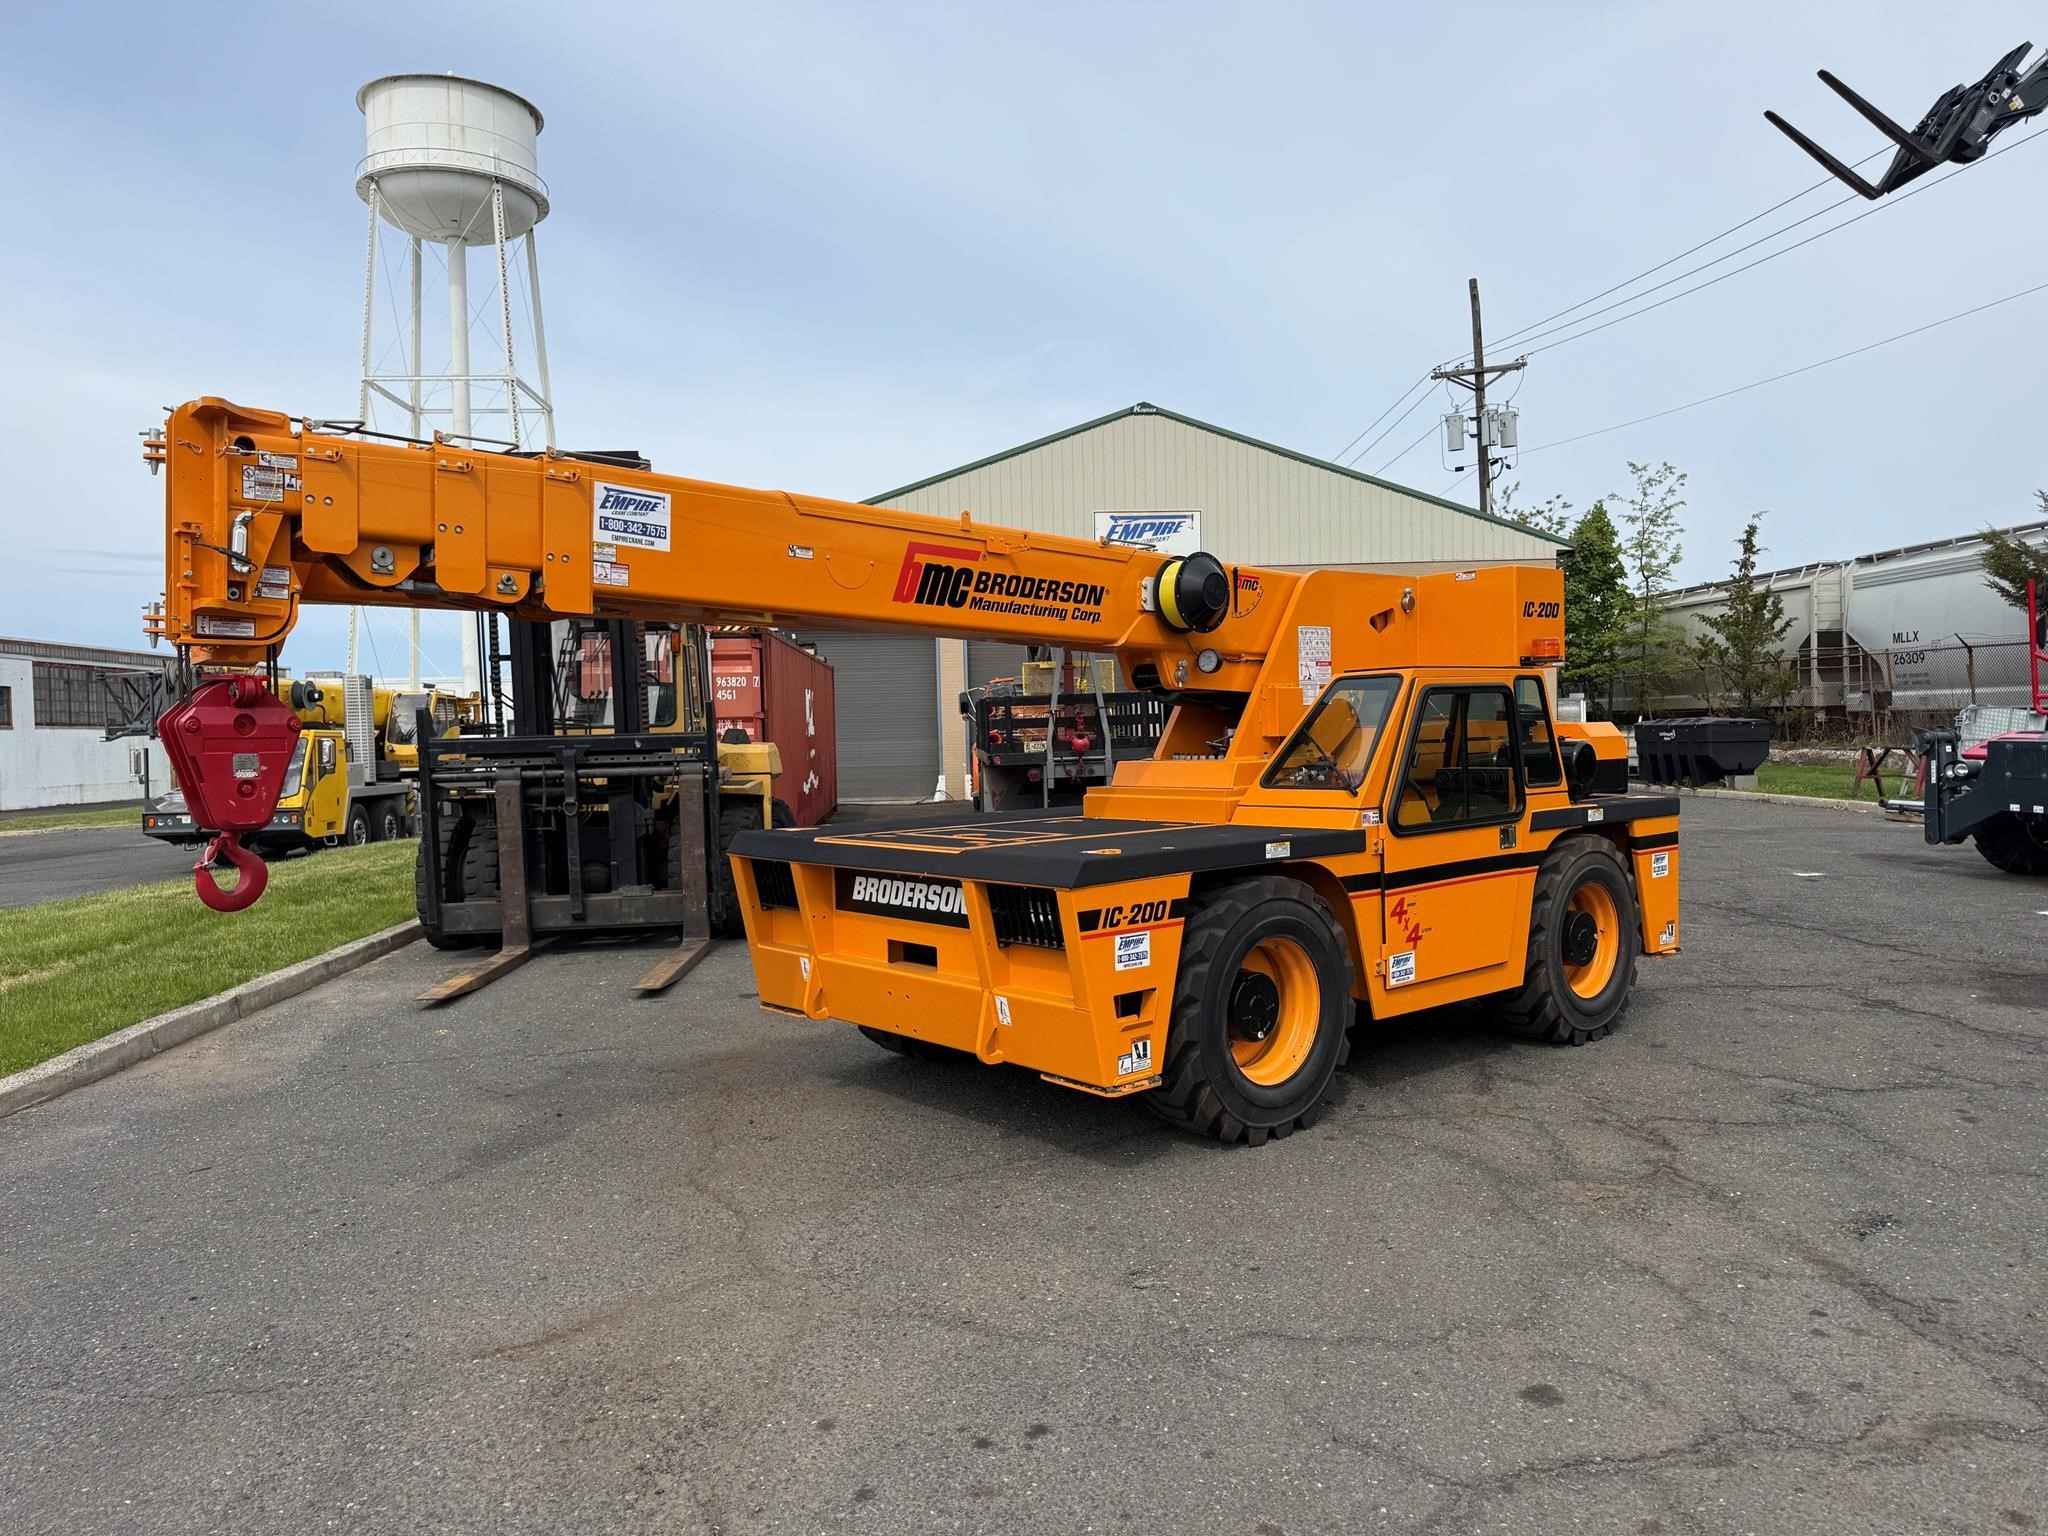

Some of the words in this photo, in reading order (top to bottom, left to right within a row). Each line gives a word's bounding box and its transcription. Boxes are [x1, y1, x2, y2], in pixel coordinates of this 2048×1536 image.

[600, 494, 661, 512] EMPIRE
[600, 518, 666, 538] 1-800-342-7575
[1106, 521, 1186, 540] EMPIRE
[973, 571, 1105, 606] BRODERSON
[969, 597, 1068, 620] Manufacturing
[1071, 607, 1102, 624] Corp.
[1522, 601, 1560, 618] IC-200
[1892, 630, 1919, 643] MLLX
[1893, 652, 1925, 665] 26309
[716, 677, 747, 687] 963820
[716, 690, 737, 700] 45G1
[1102, 900, 1167, 929] IC-200
[1118, 936, 1145, 951] EMPIRE
